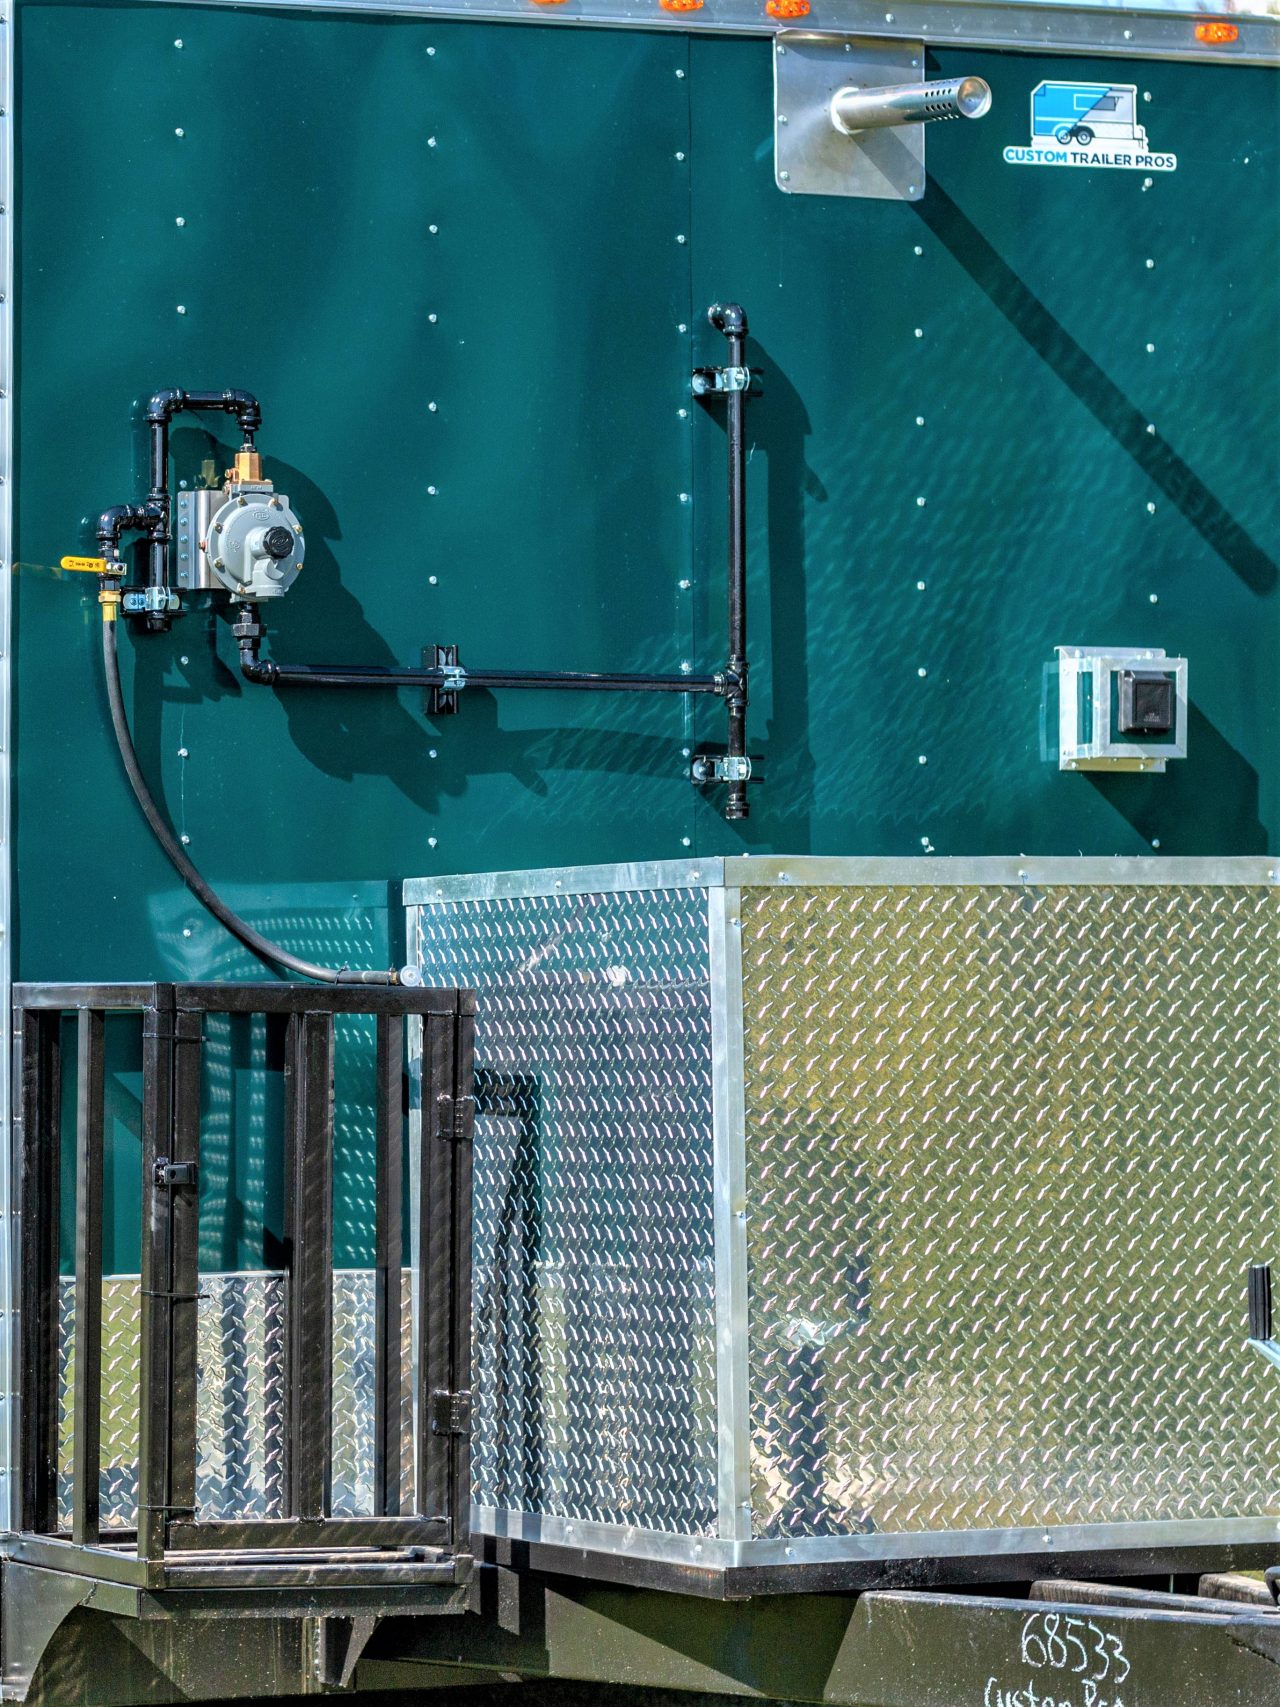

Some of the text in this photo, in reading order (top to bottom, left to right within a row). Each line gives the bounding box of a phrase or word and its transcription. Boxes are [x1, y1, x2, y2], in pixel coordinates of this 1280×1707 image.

[1004, 148, 1175, 168] CUSTOM TRAILER PROS
[1021, 1613, 1131, 1684] 68533
